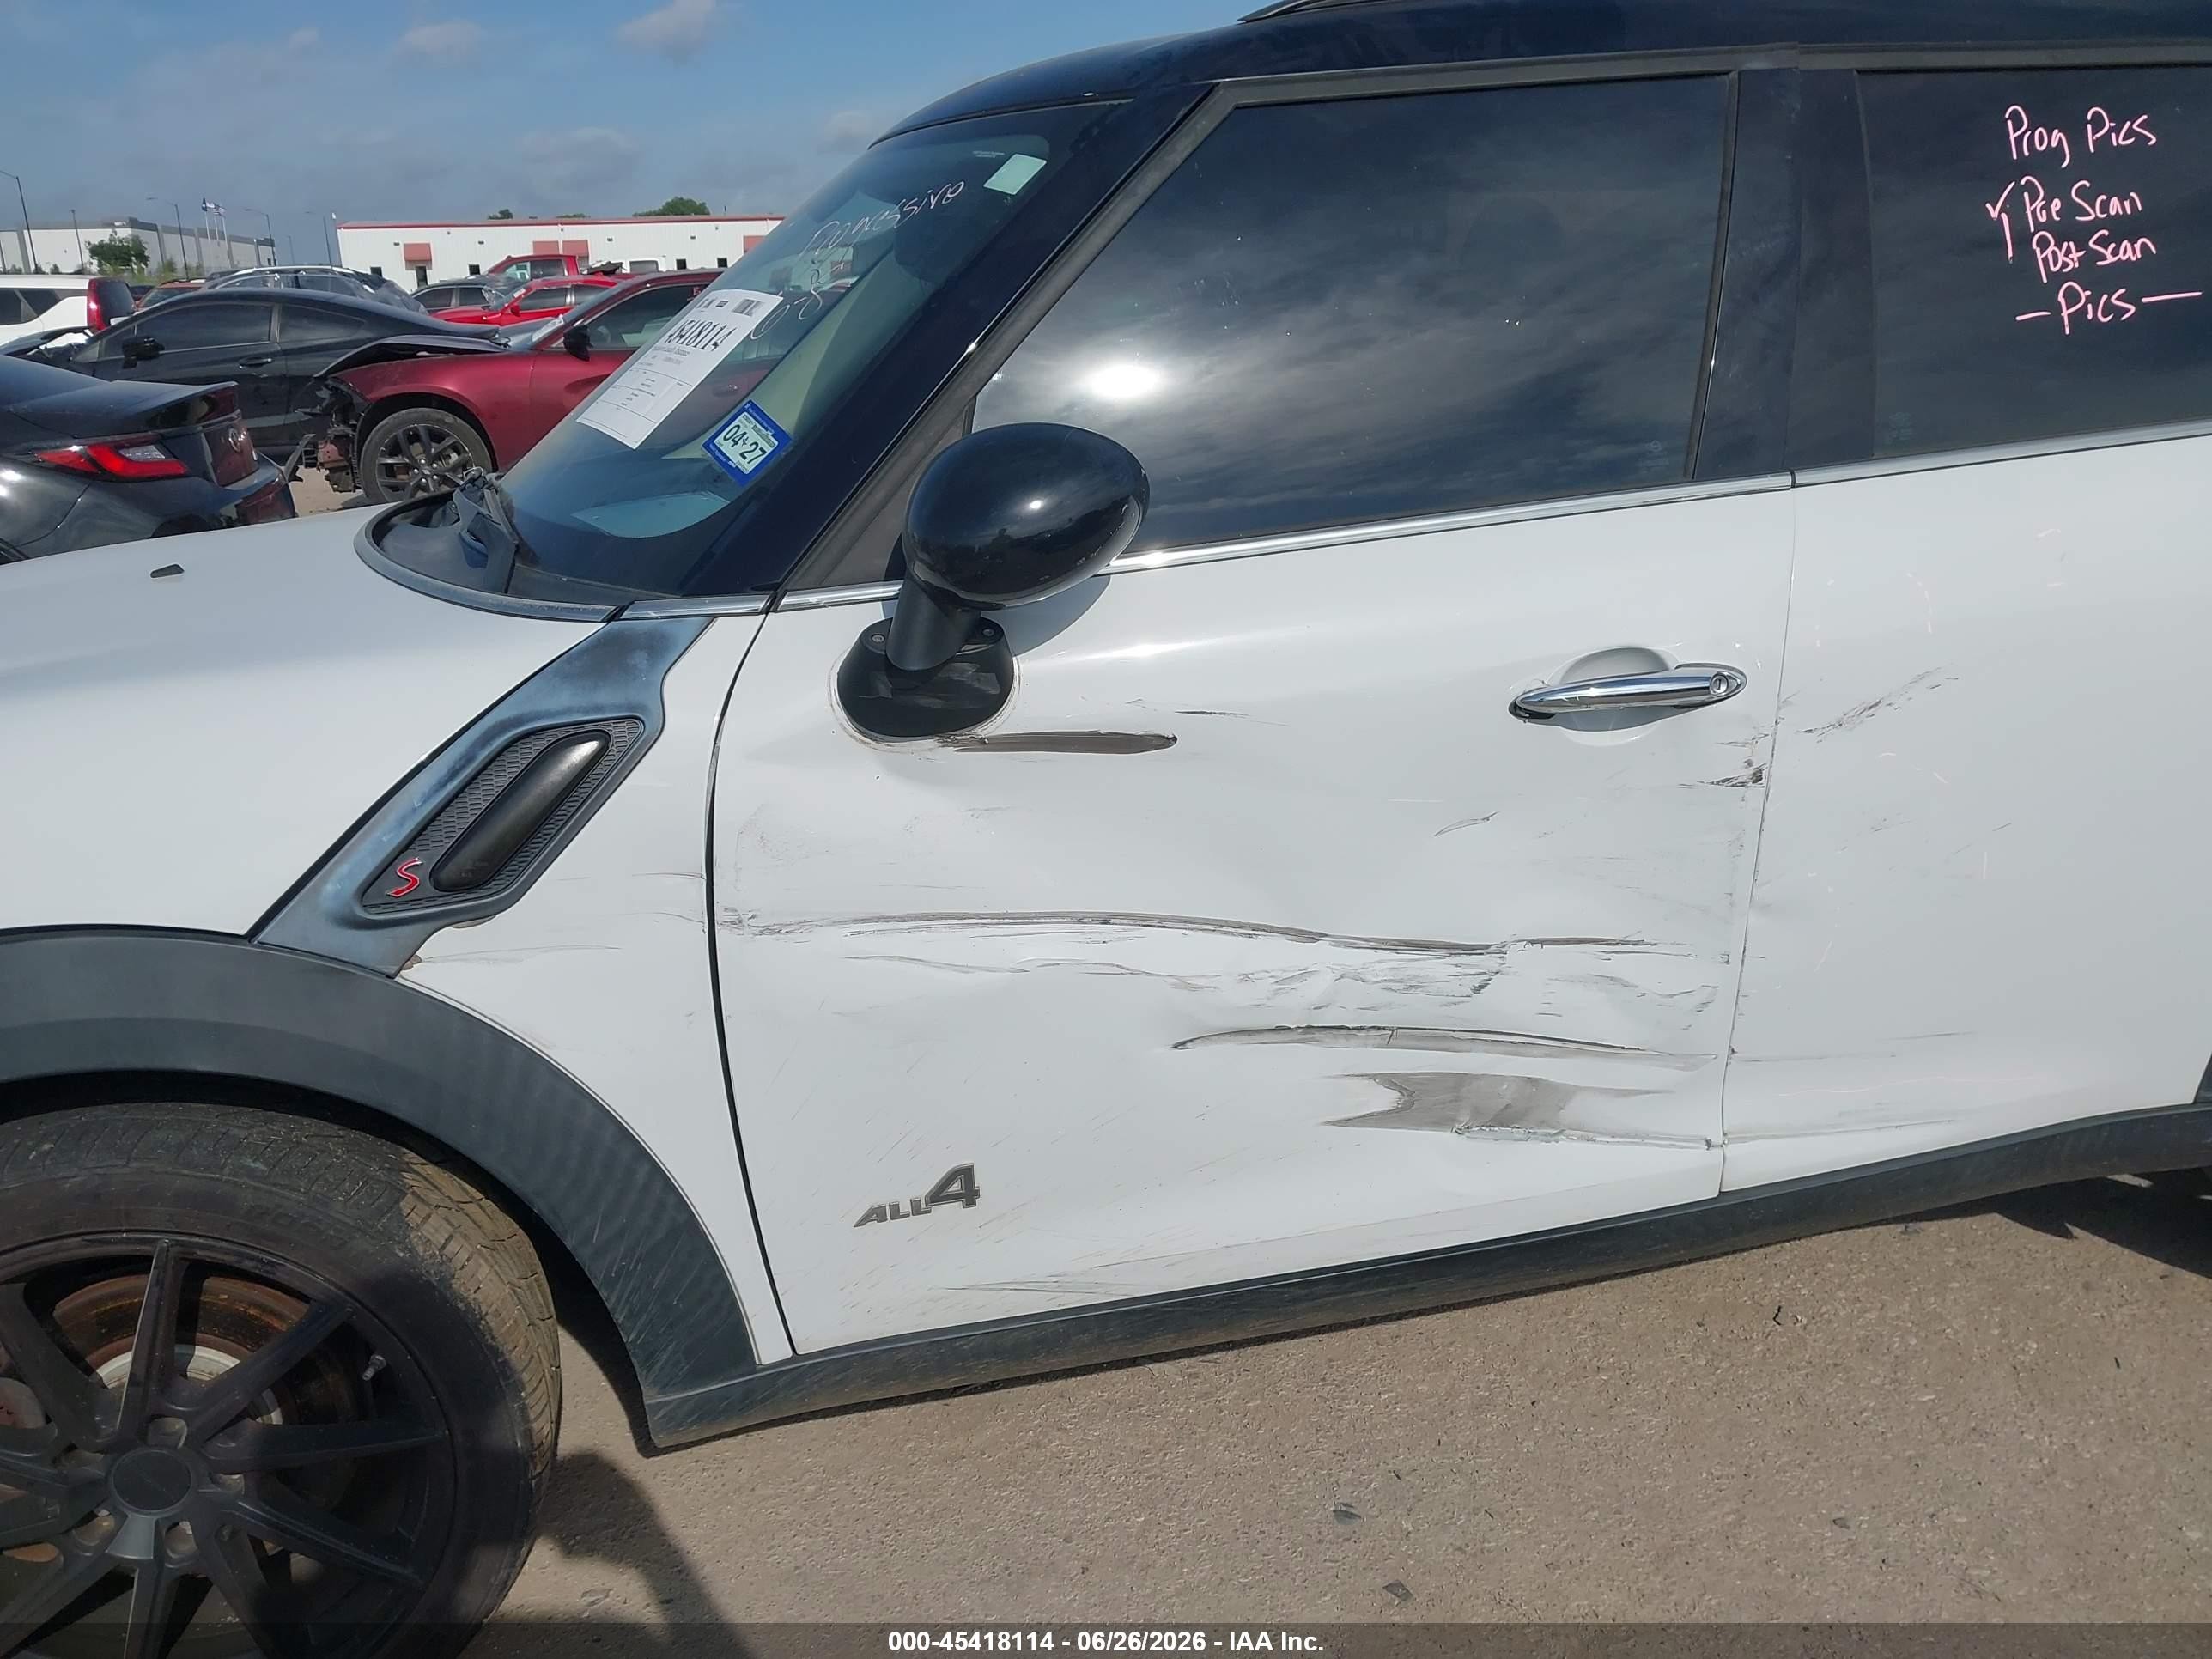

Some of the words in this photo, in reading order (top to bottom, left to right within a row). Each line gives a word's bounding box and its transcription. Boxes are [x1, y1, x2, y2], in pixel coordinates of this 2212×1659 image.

[2005, 105, 2070, 168] Prog
[2020, 175, 2062, 233] Pre
[2071, 179, 2143, 221] Scan
[2032, 230, 2086, 283] Post
[2088, 229, 2157, 265] Scan
[386, 857, 422, 897] S
